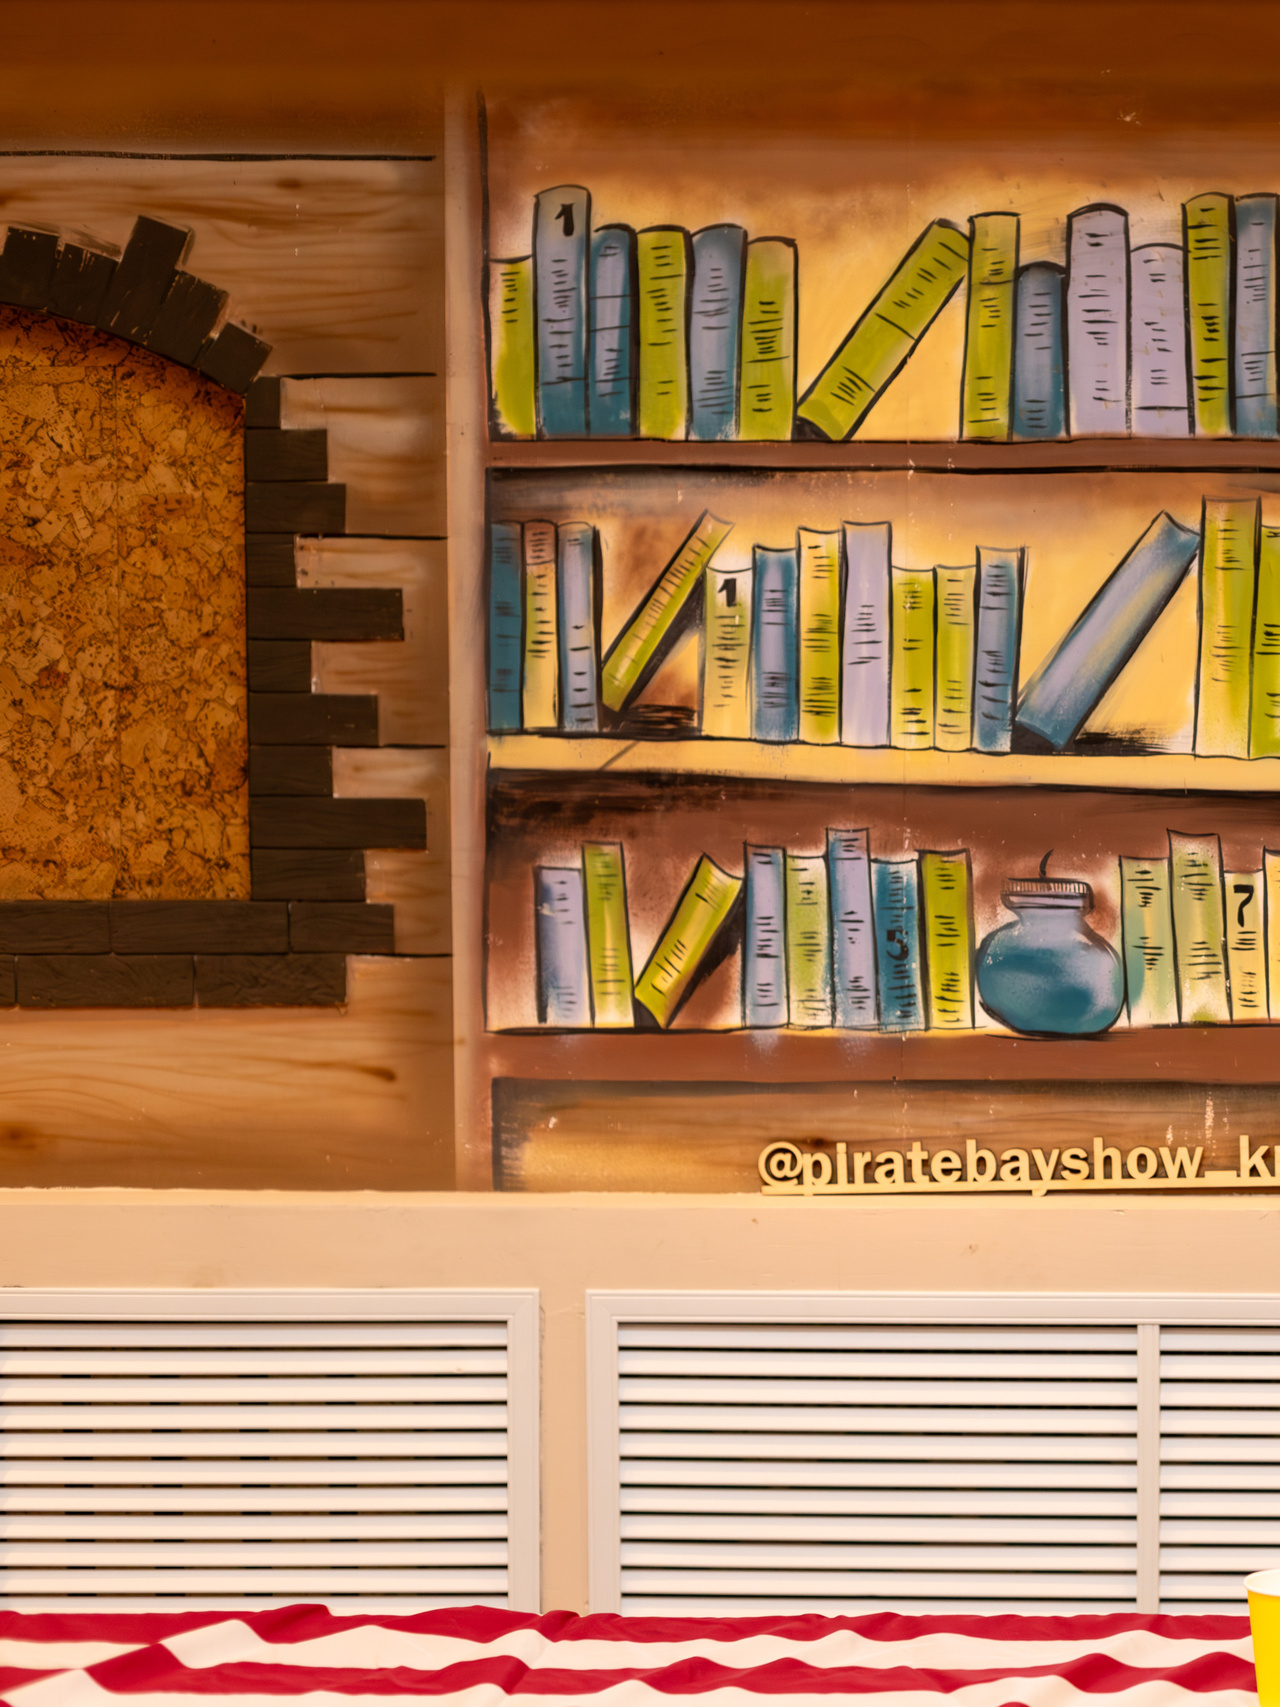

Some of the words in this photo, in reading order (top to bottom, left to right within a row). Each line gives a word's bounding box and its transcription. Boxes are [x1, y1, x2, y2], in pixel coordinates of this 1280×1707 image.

[554, 202, 575, 237] 1
[717, 577, 737, 607] 1
[1233, 884, 1254, 928] 7
[885, 926, 909, 961] 5
